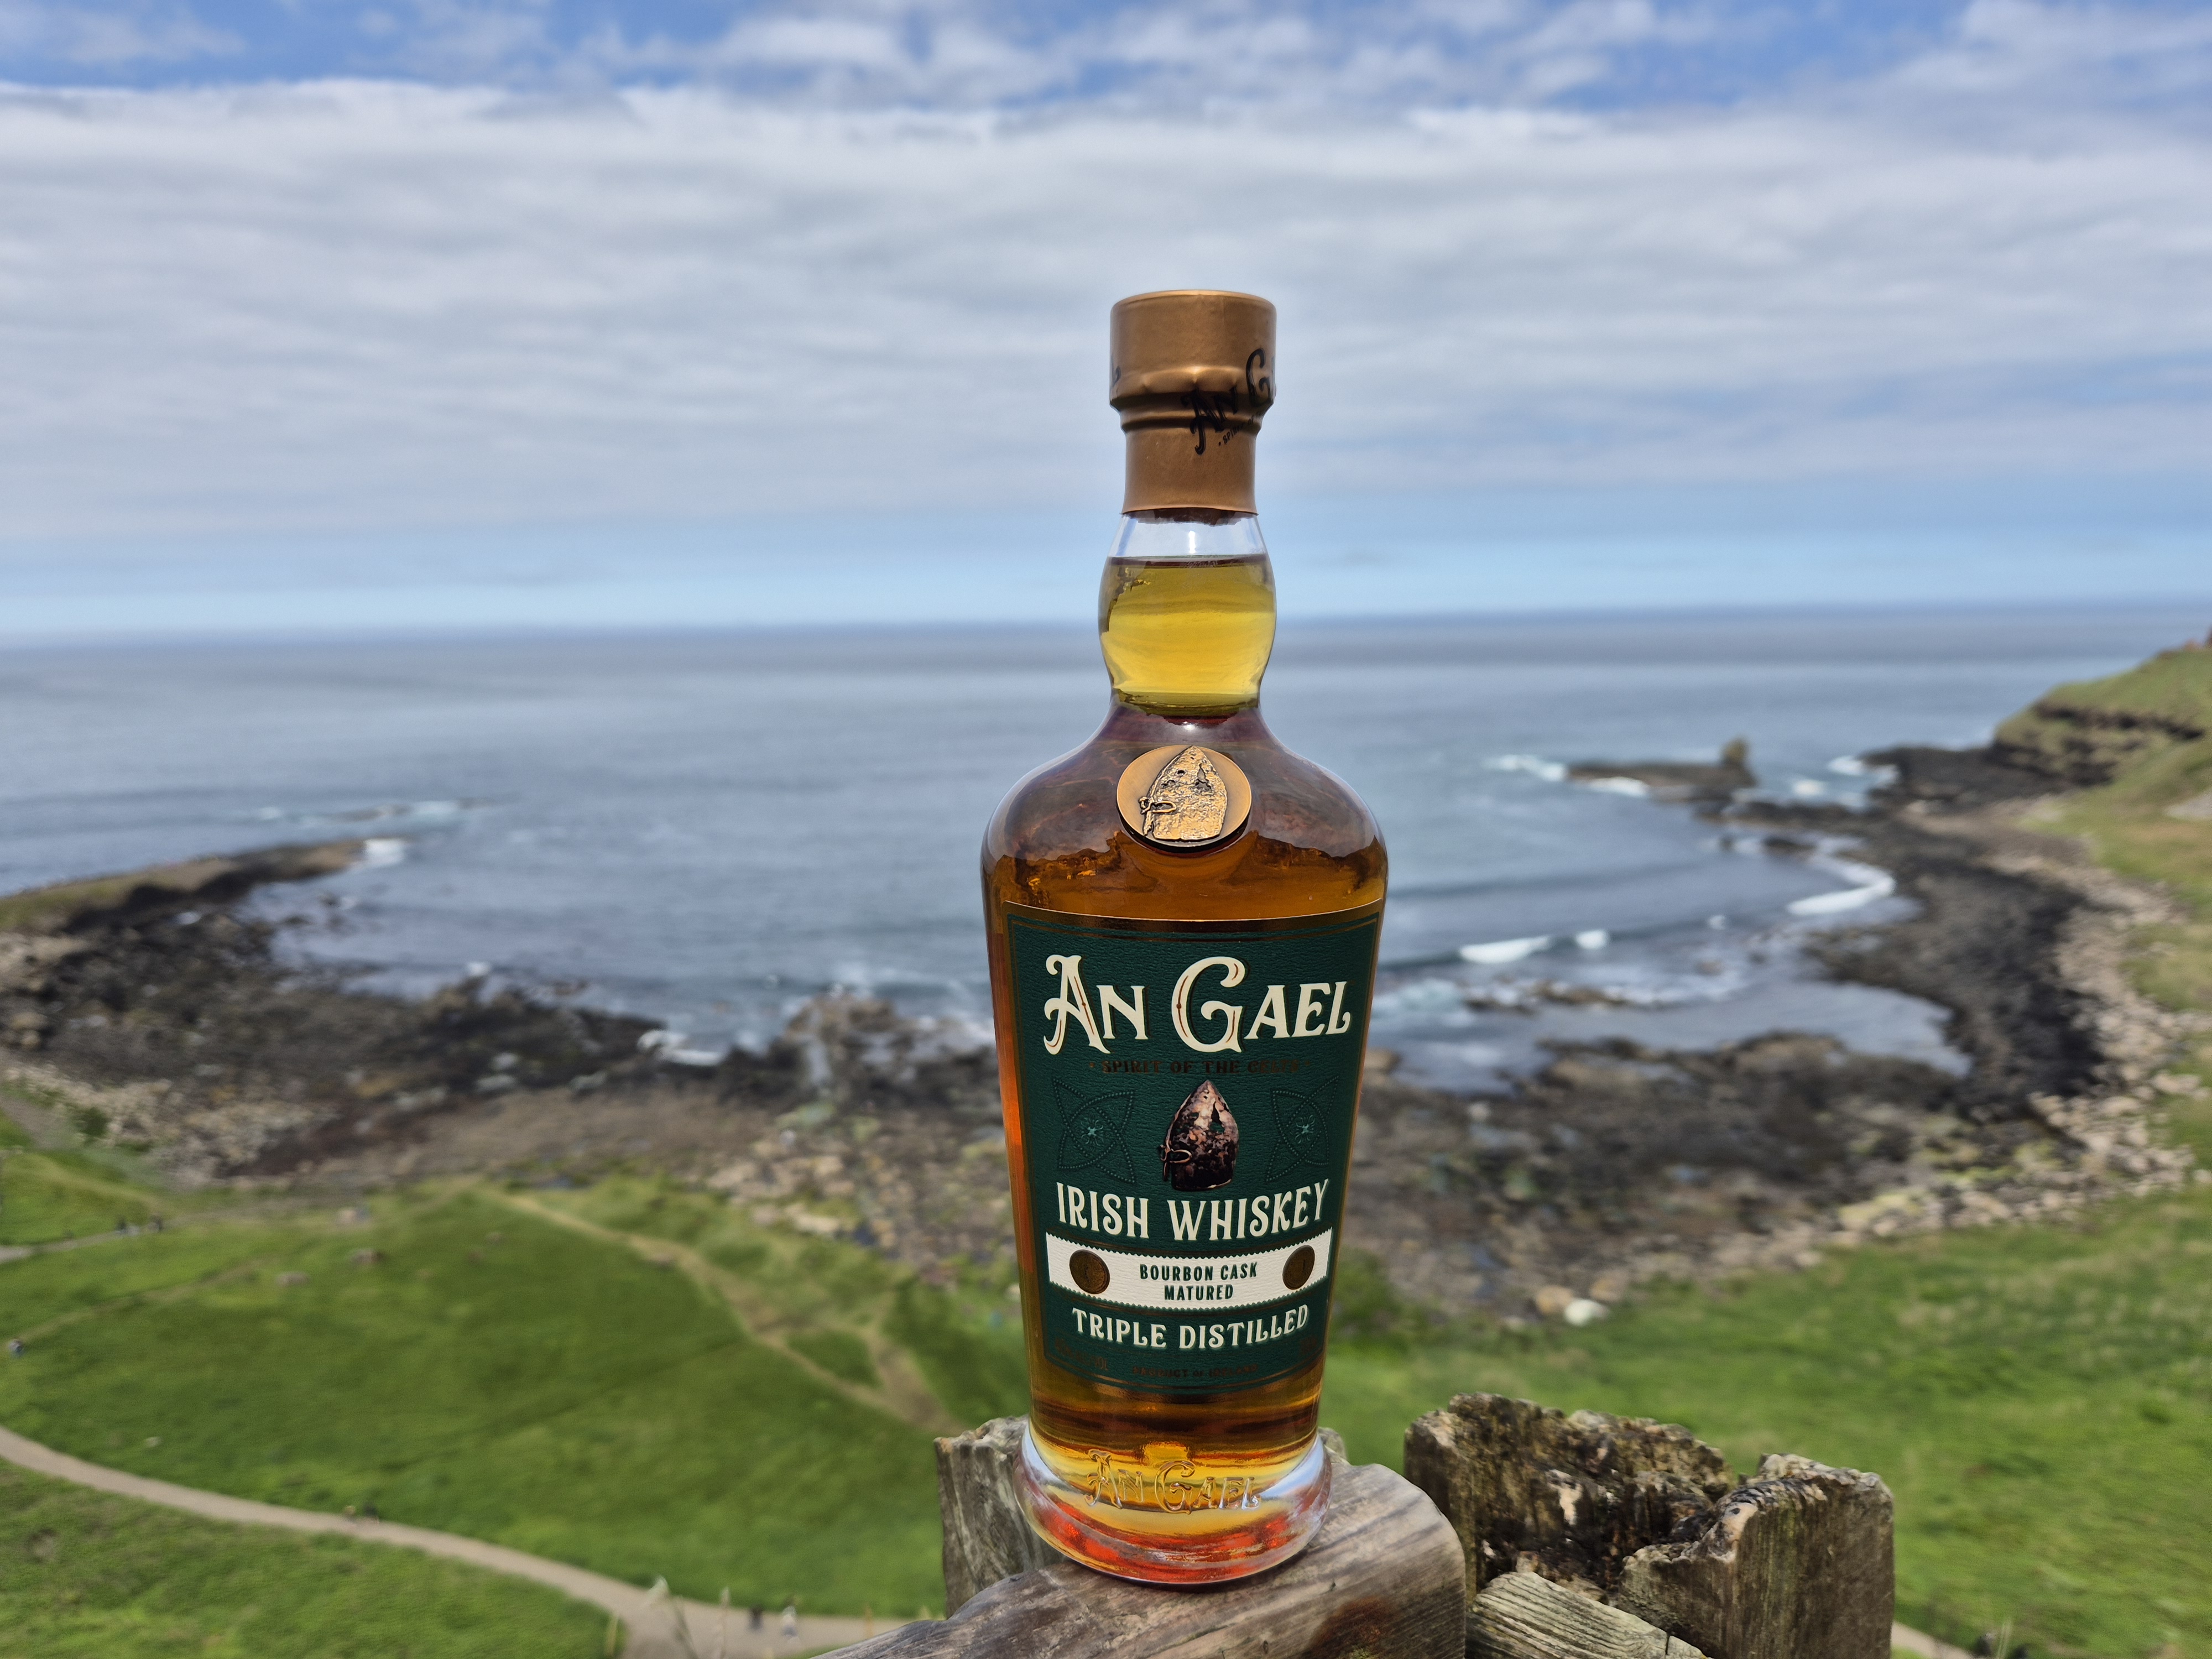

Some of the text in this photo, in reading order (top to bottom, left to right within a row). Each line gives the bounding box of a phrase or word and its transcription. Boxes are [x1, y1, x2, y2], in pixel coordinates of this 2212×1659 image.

[1102, 1059, 1300, 1074] SPIRIT OF THE CELTS
[1056, 1178, 1330, 1241] IRISH WHISKEY
[1140, 1261, 1258, 1281] BOURBON CASK
[1164, 1284, 1233, 1301] MATURED
[1072, 1307, 1167, 1349] TRIPLE
[1178, 1304, 1310, 1349] DISTILLED
